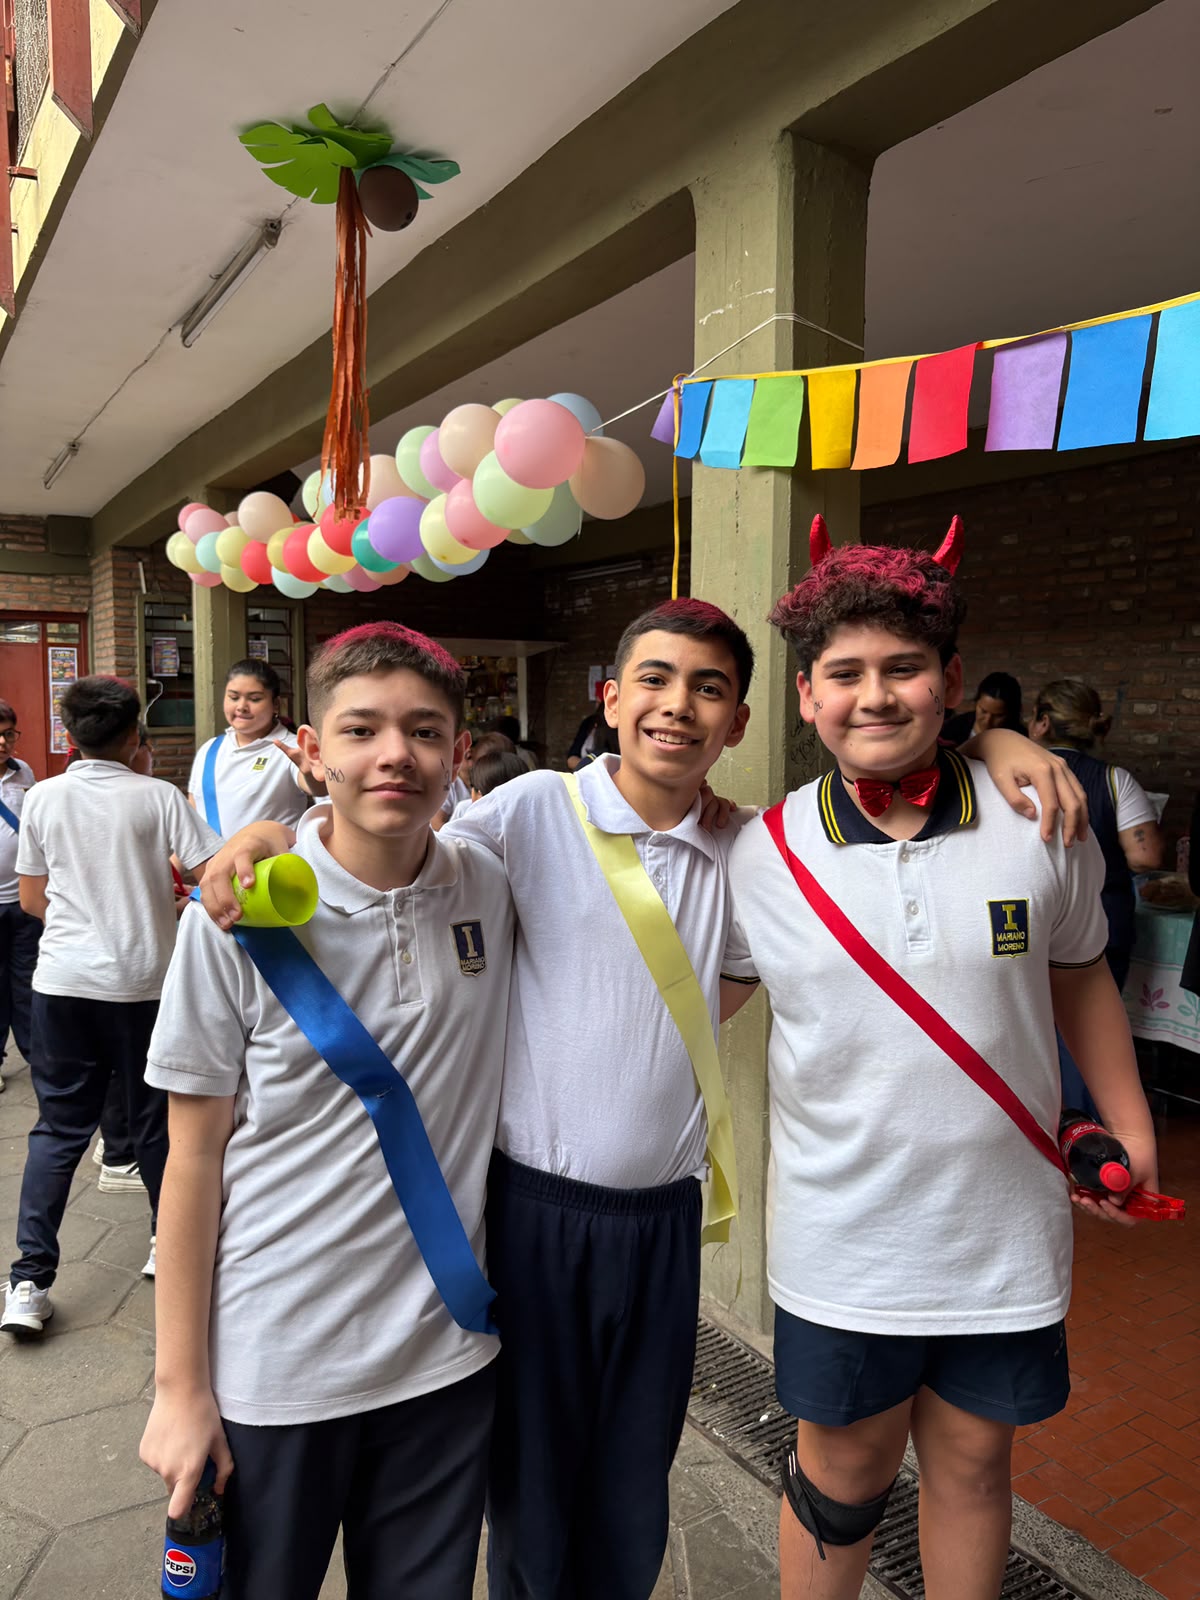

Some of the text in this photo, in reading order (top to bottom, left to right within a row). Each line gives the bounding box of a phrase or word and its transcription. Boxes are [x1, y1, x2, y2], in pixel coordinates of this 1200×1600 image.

[996, 931, 1026, 942] MARIANO
[997, 942, 1025, 952] MORENO
[165, 1558, 194, 1575] PEPSI
